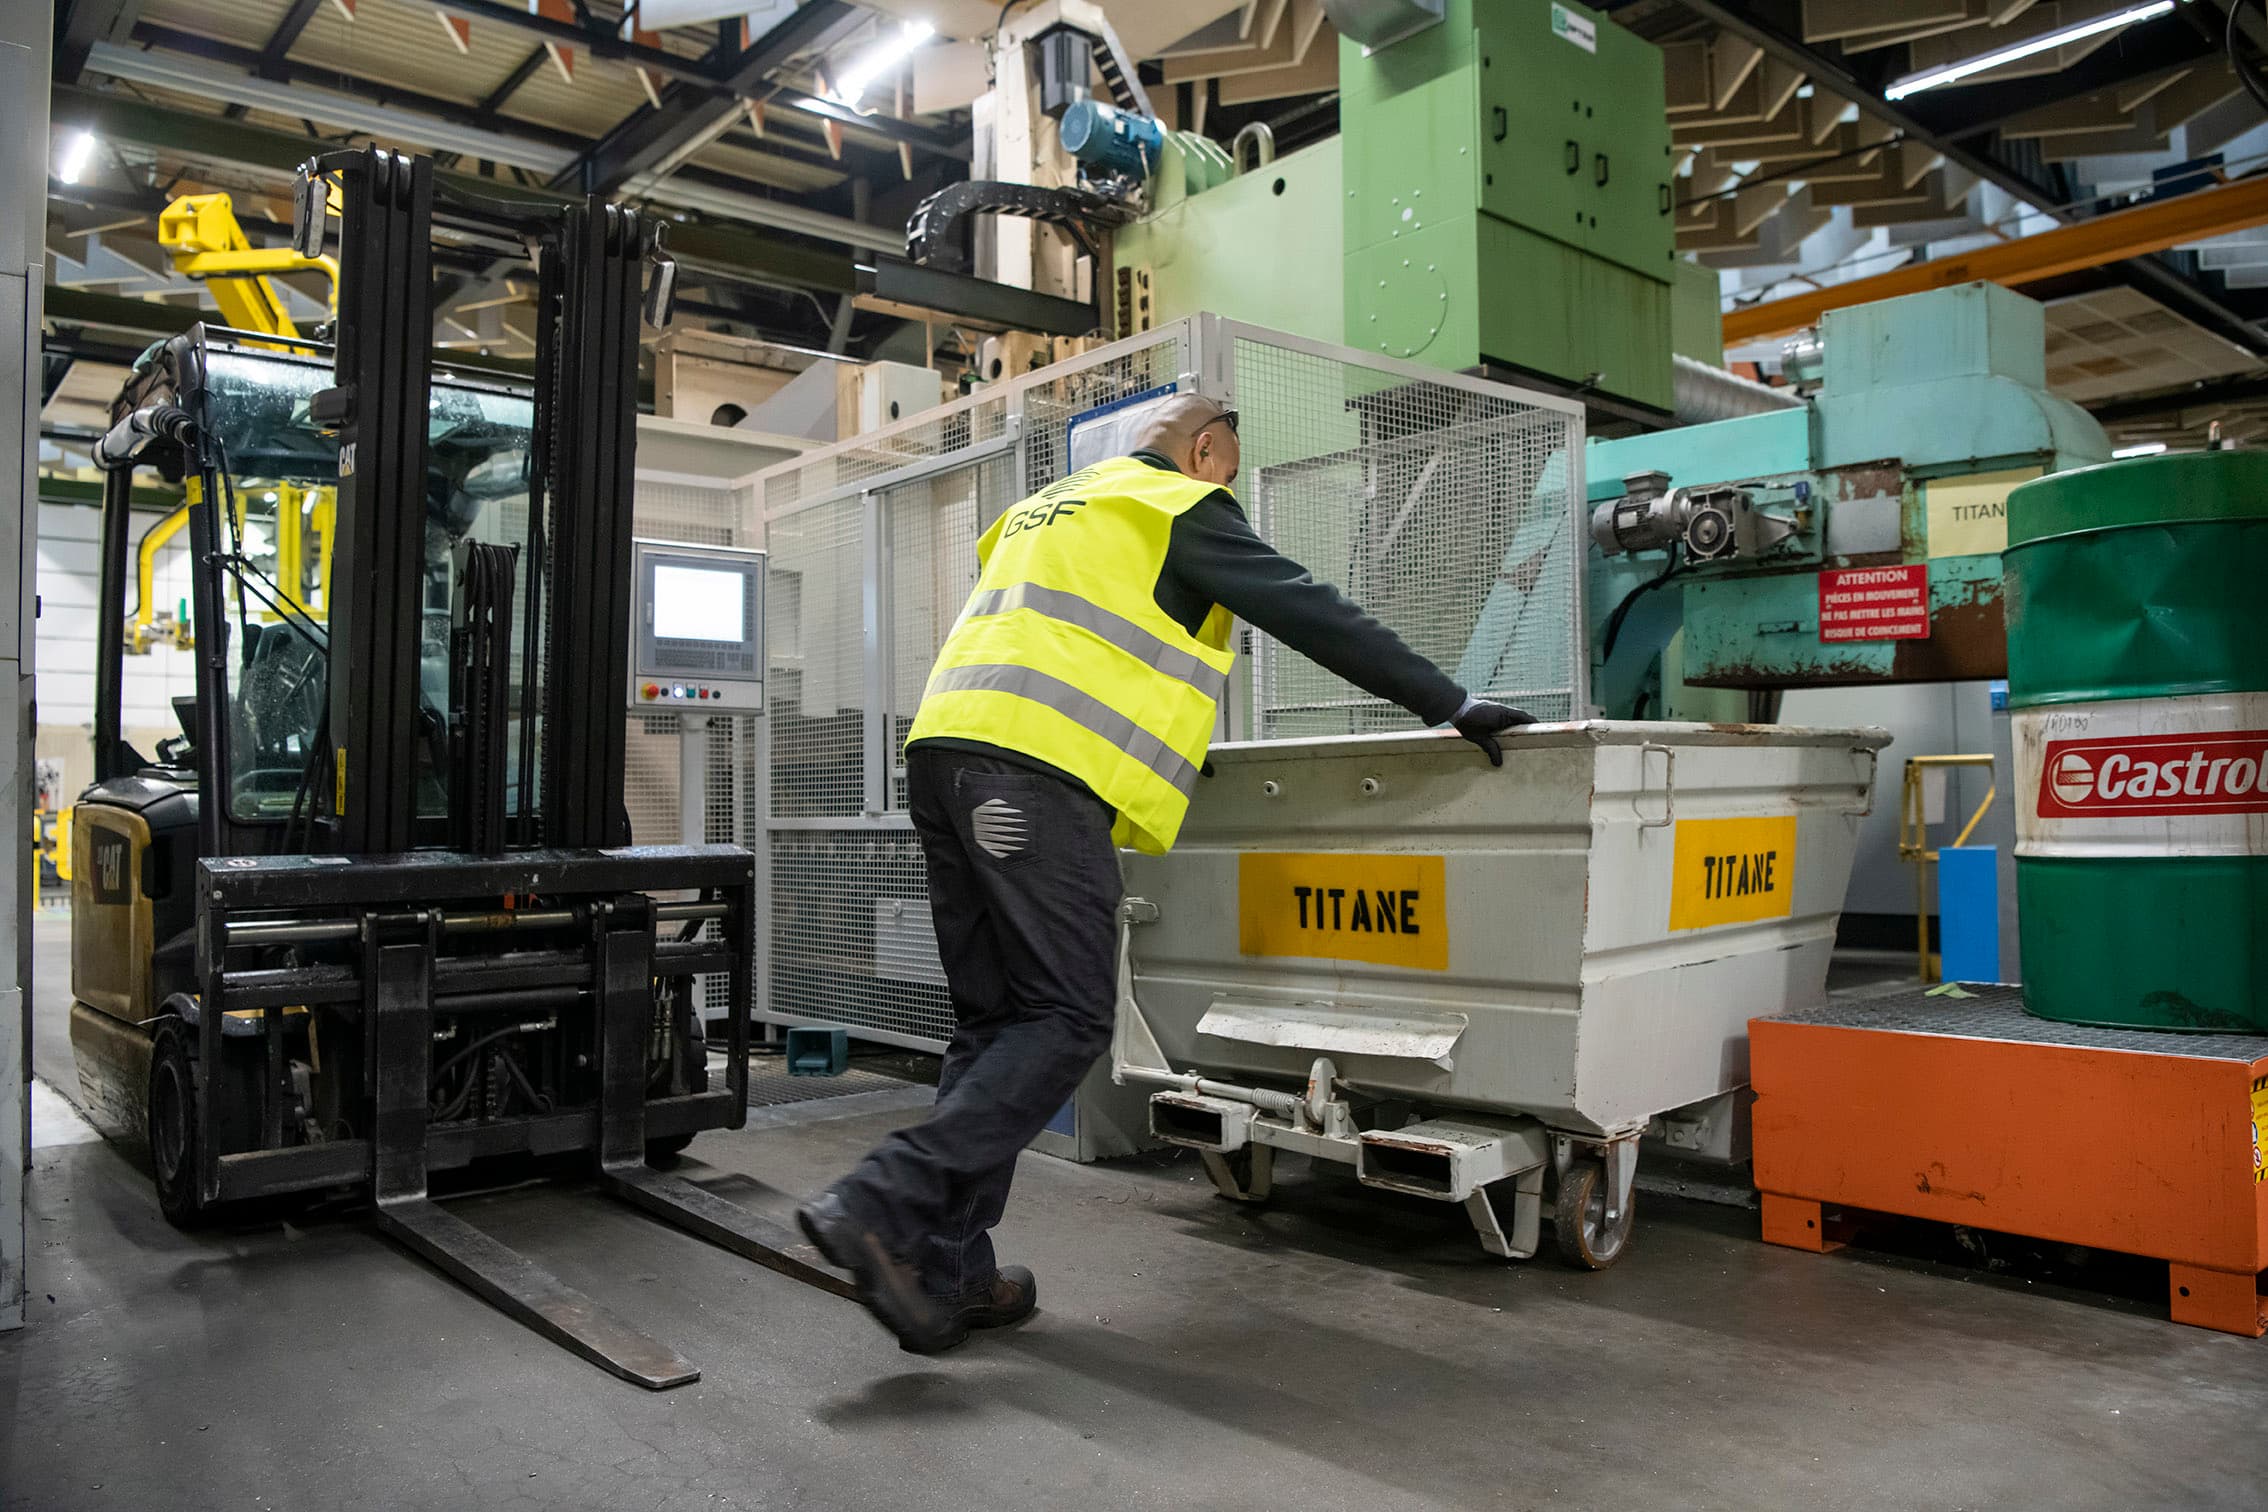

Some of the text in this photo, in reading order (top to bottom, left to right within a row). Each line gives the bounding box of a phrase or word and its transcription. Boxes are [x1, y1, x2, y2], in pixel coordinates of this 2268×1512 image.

[339, 442, 356, 477] CAT
[1004, 500, 1087, 538] GSF
[1952, 503, 2005, 521] TITAN
[1837, 570, 1908, 586] ATTENTION
[1853, 592, 1864, 602] EN
[1866, 588, 1919, 601] MOUVEMENT
[1821, 606, 1925, 621] NE PAS METTRE LES MAINS
[1824, 623, 1921, 638] RISQUE DE COINCEMENT
[2097, 749, 2268, 800] Castrol
[103, 844, 122, 890] CAT
[1704, 851, 1776, 900] TITANE
[1294, 886, 1420, 934] TITANE
